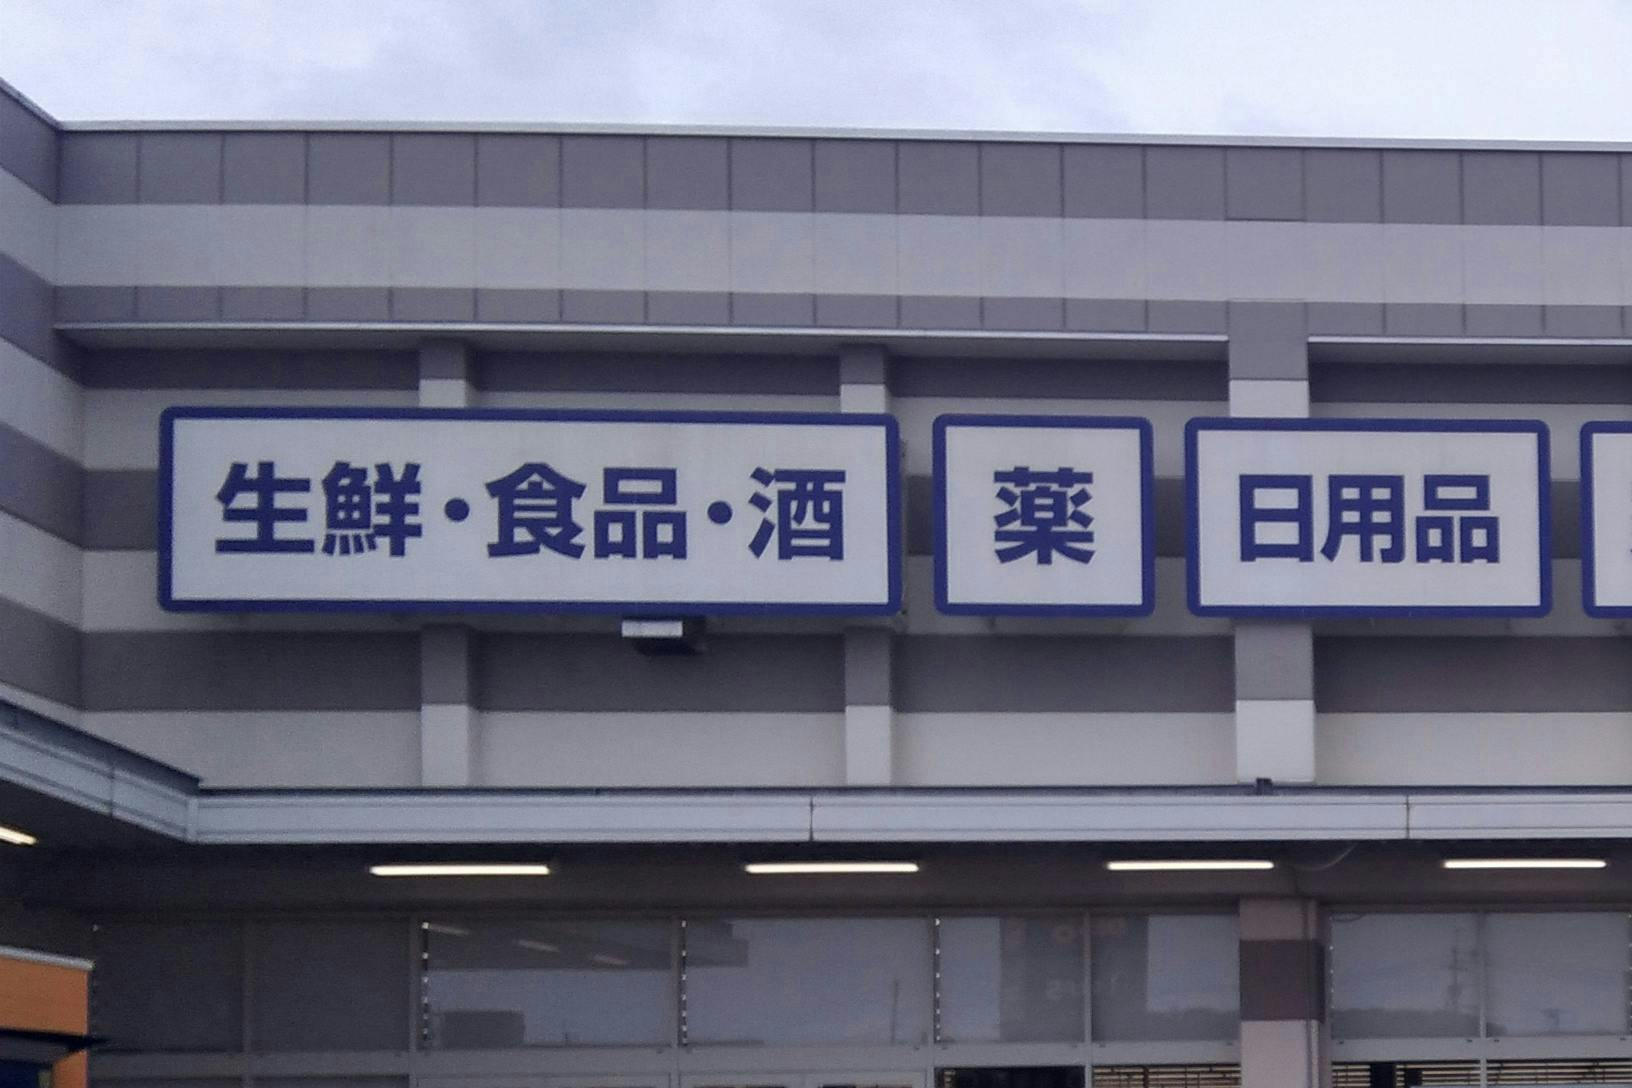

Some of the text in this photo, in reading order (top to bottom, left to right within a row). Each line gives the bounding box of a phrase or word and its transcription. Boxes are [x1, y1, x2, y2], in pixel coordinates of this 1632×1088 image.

[215, 461, 846, 561] 生鮮・食品・酒
[994, 466, 1095, 565] 薬
[1239, 474, 1499, 563] 日用品
